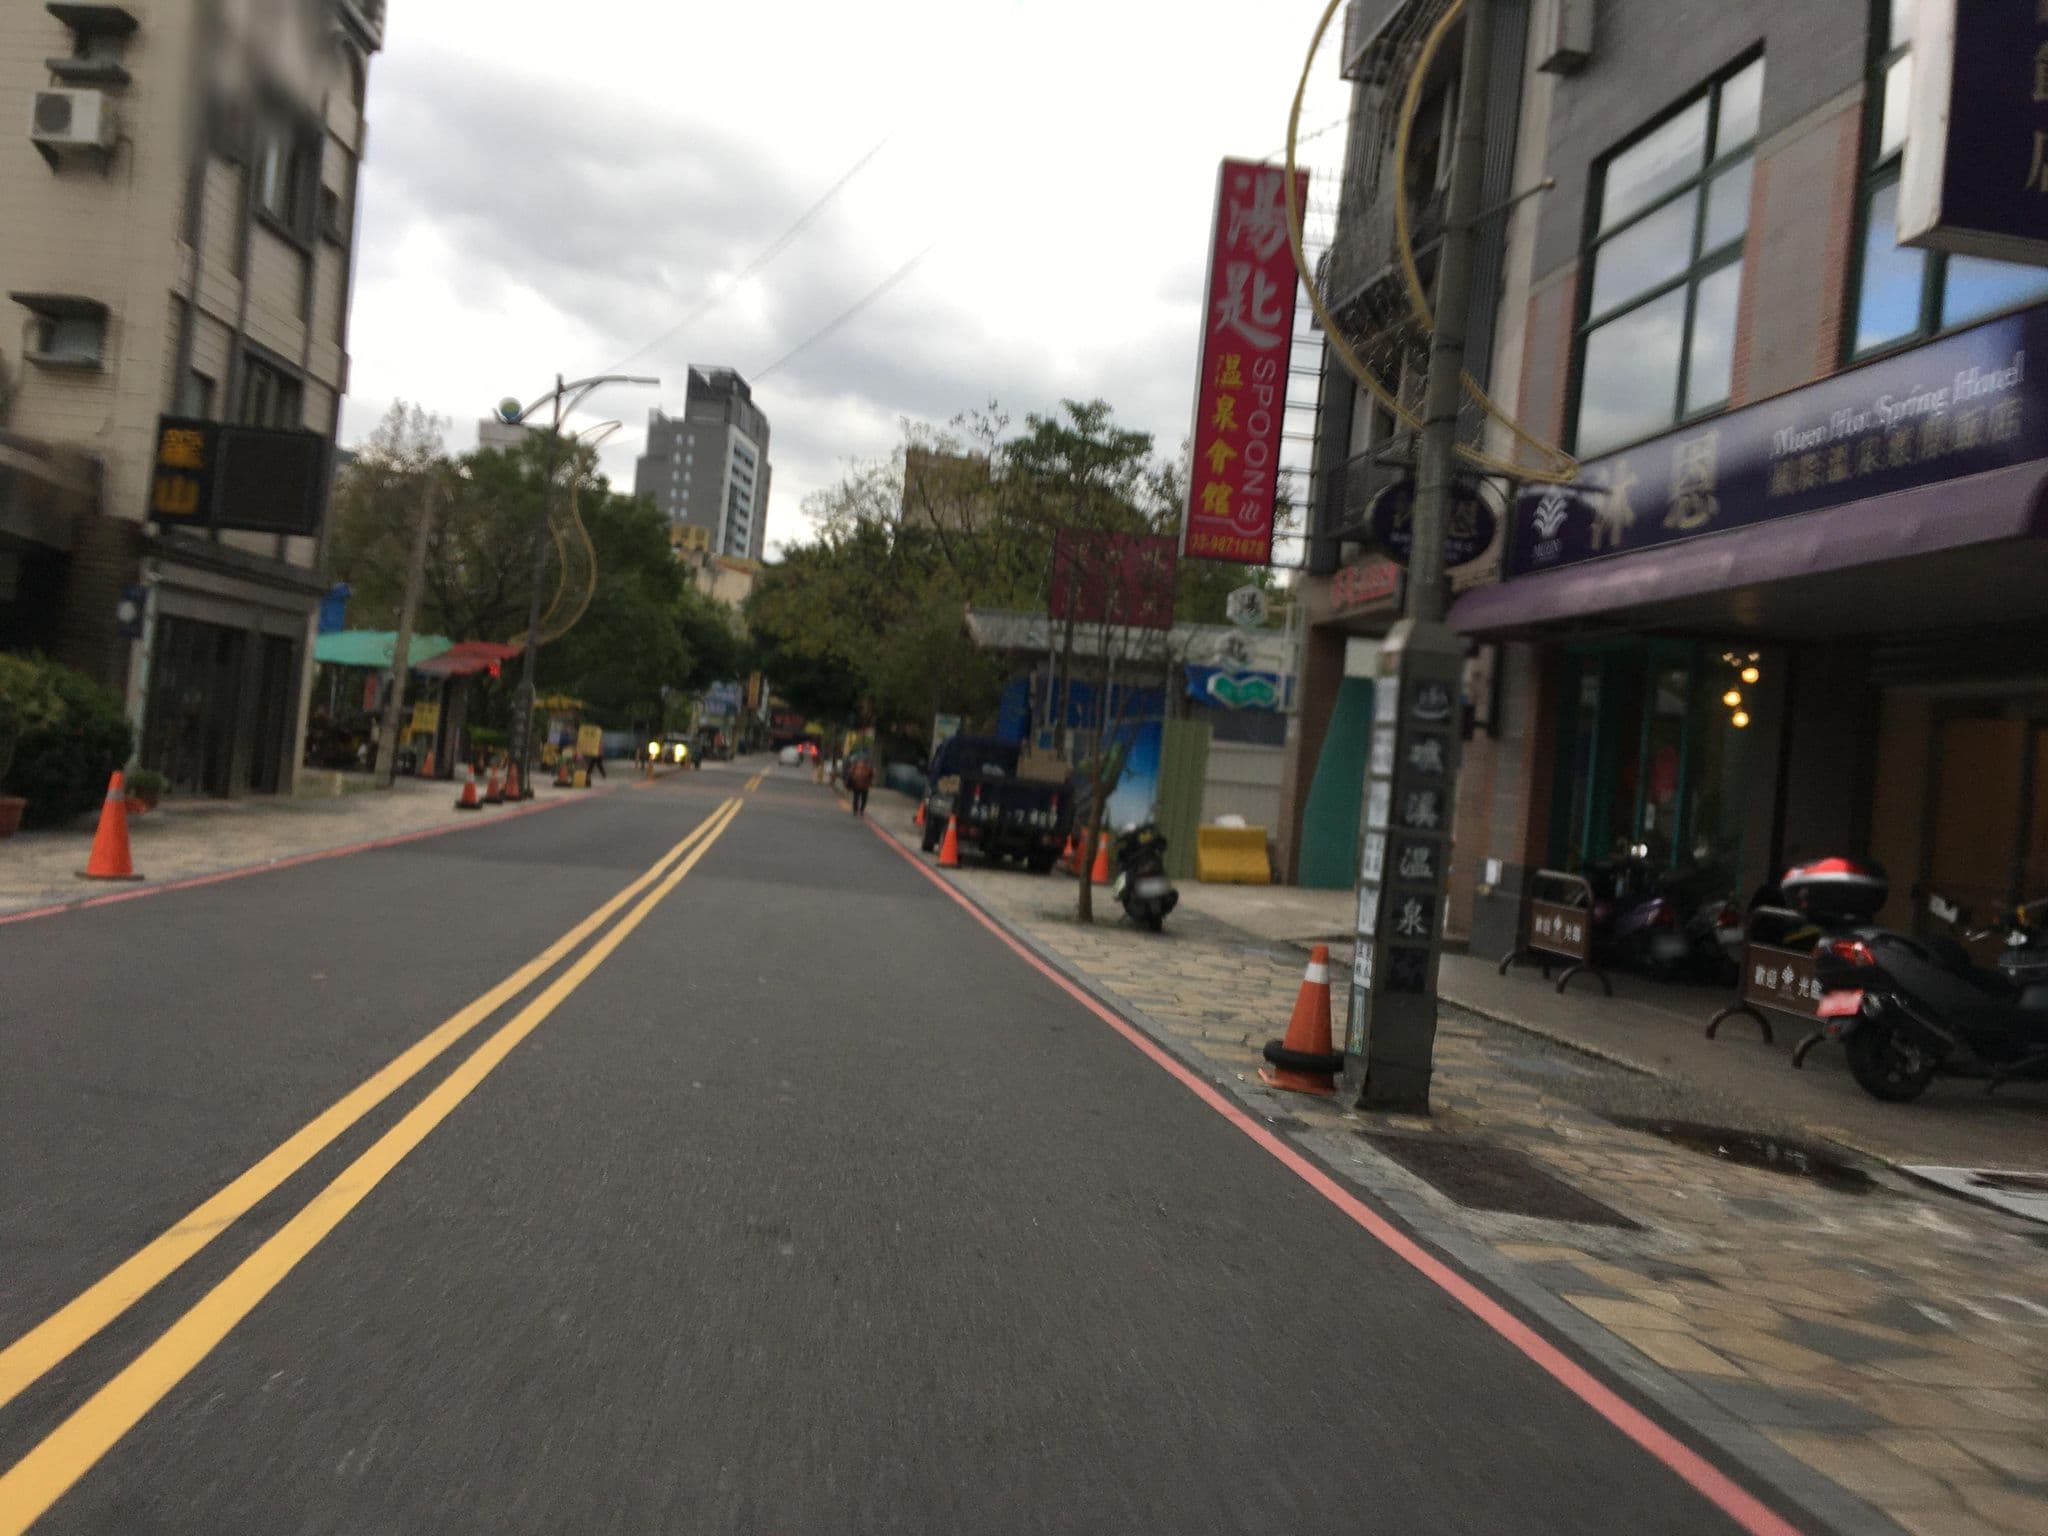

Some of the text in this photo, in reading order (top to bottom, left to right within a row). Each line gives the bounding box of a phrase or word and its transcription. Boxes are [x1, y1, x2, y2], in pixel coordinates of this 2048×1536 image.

[1215, 173, 1287, 350] 湯匙
[1201, 352, 1244, 517] 溫泉會館
[1241, 356, 1277, 497] SPOON
